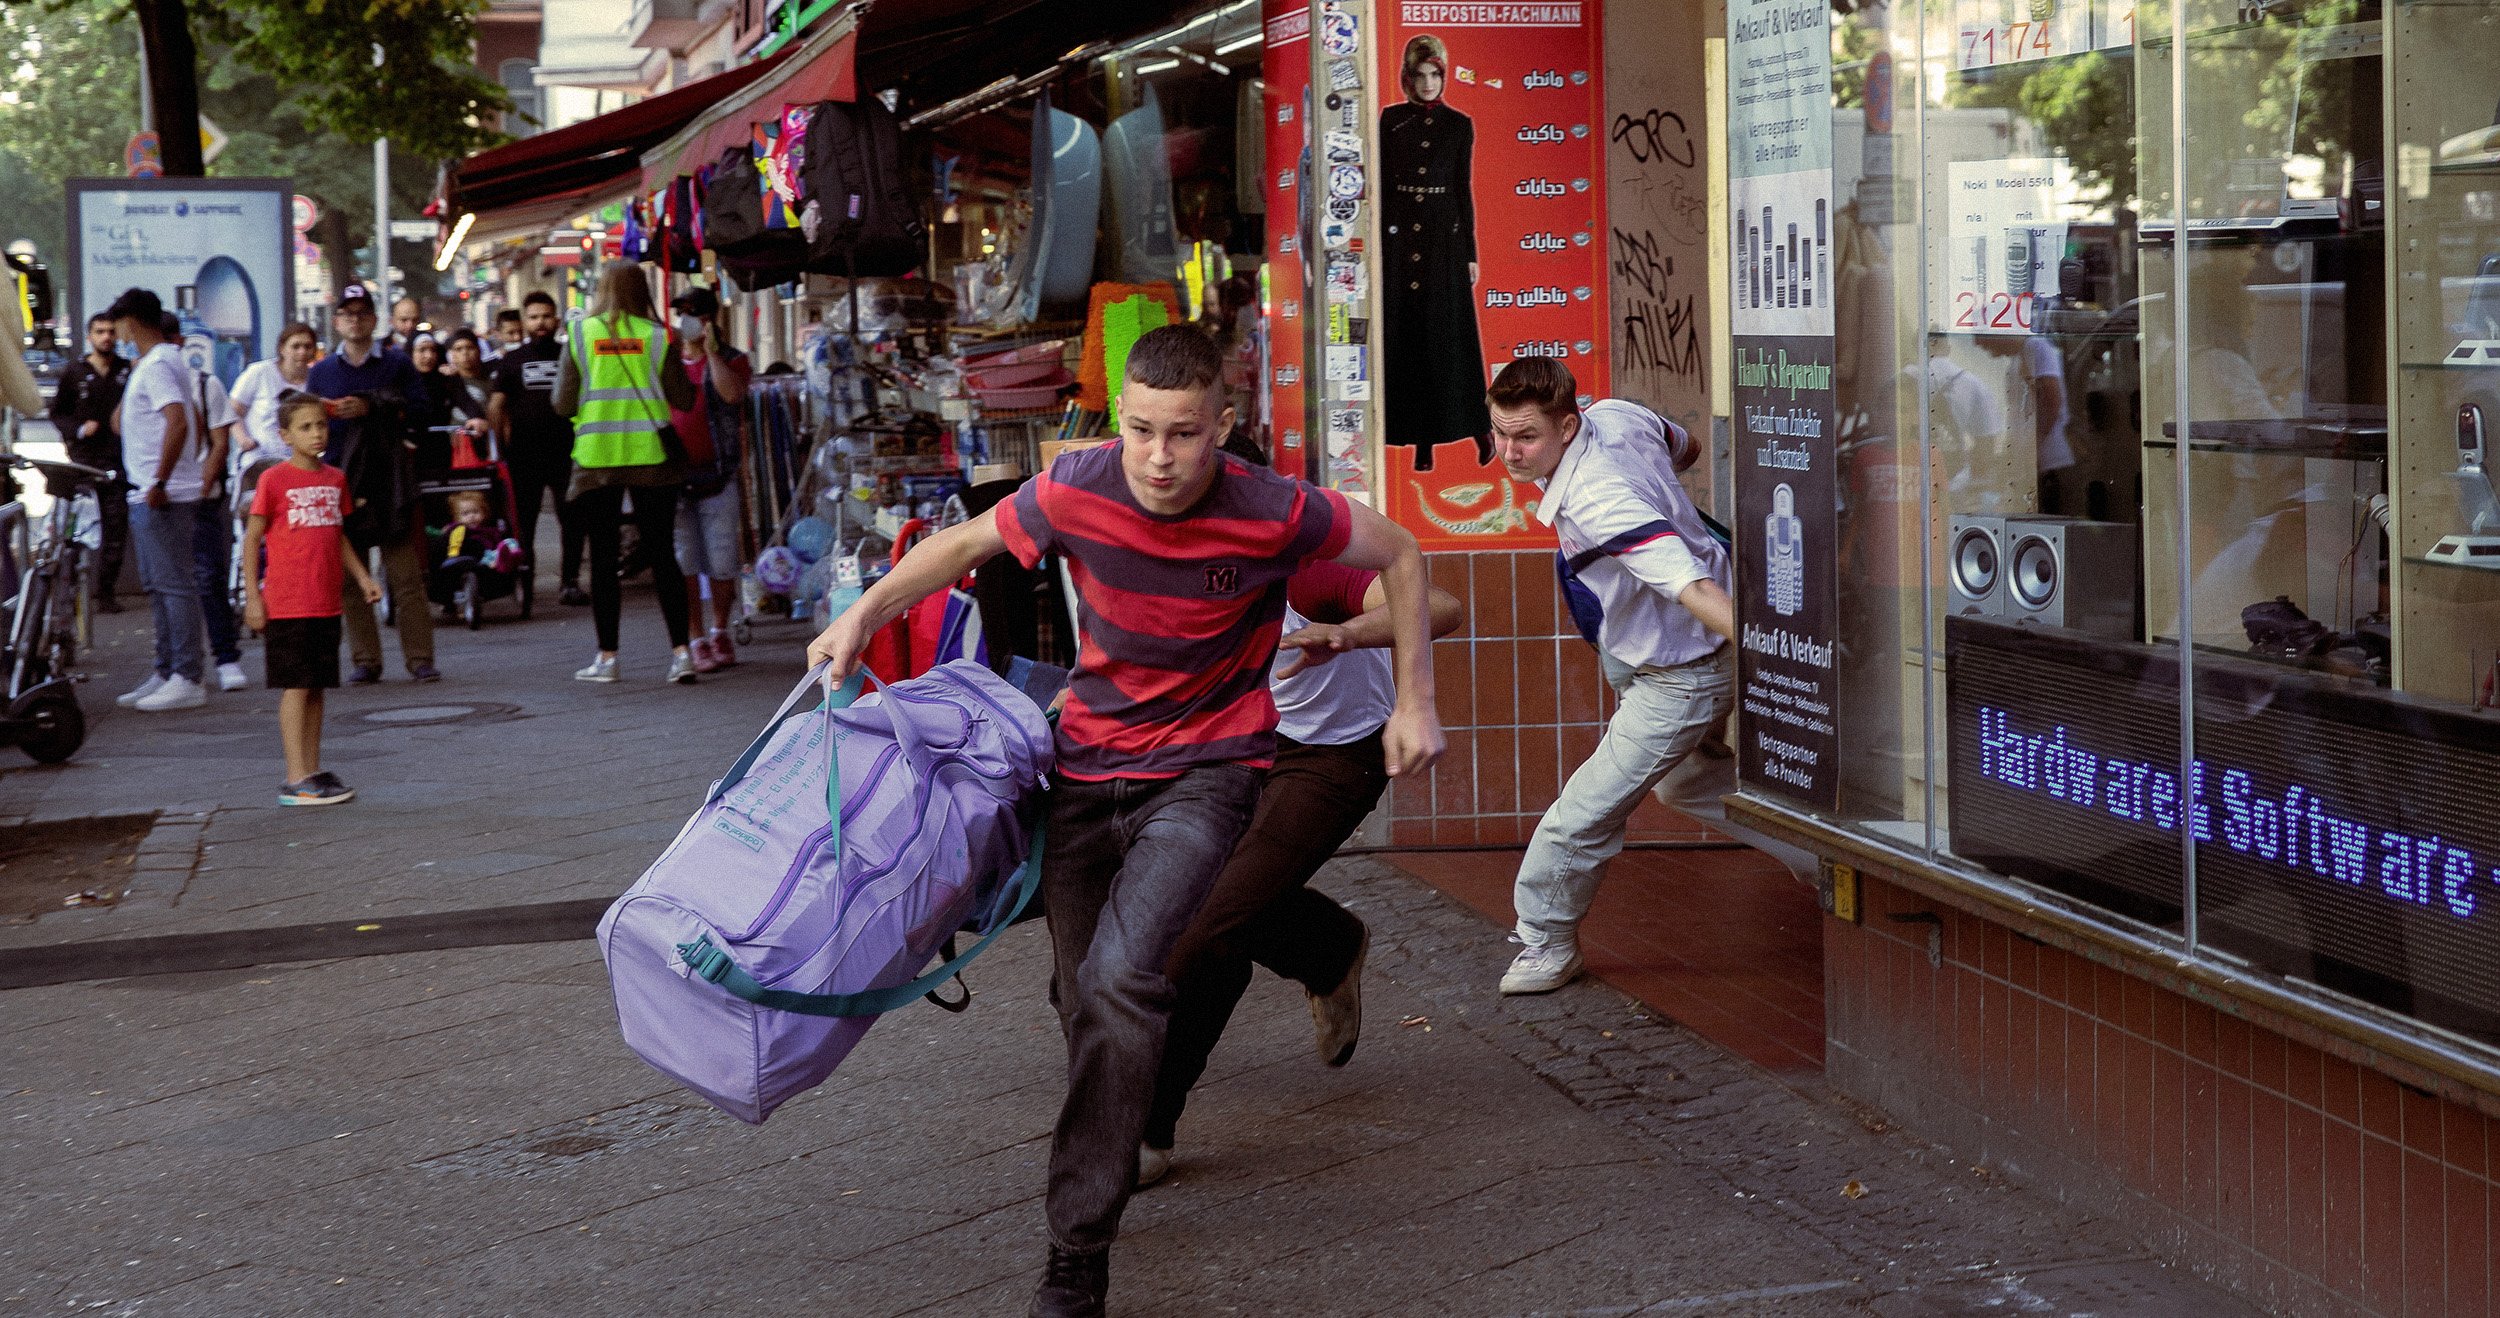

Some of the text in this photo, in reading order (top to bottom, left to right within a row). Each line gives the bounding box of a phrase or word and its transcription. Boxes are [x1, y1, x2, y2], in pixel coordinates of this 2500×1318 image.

[1402, 6, 1581, 22] RESTPOSTEN-FACHMANN
[1773, 8, 1780, 36] &
[1516, 123, 1567, 145] جاكيت
[1515, 177, 1567, 198] حجابات
[1995, 178, 2026, 189] Model
[2028, 177, 2054, 188] 5510
[2015, 211, 2033, 221] mit
[1520, 231, 1567, 253] عبايات
[1485, 286, 1568, 307] بناطلين جينز
[1778, 349, 1831, 401] Reparatur
[1742, 622, 1833, 669] Ankauf & Verkauf
[1759, 730, 1818, 765] Vertragspartner
[1764, 757, 1813, 789] alle Provider
